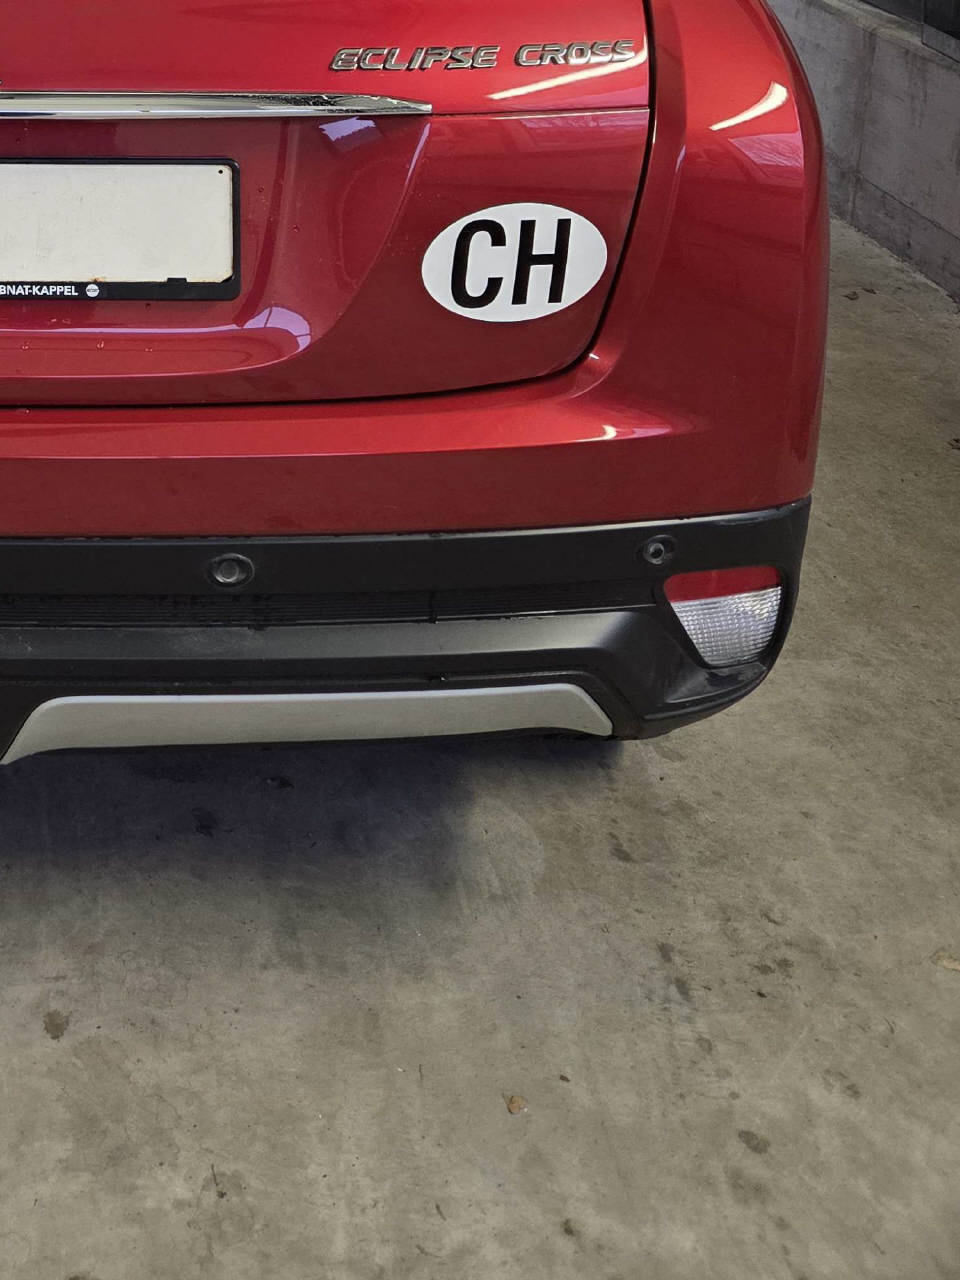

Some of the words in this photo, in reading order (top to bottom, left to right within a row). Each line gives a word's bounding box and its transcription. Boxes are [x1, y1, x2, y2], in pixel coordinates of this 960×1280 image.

[330, 45, 501, 71] ECLIPSE
[514, 39, 636, 67] CROSS
[451, 218, 572, 309] CH
